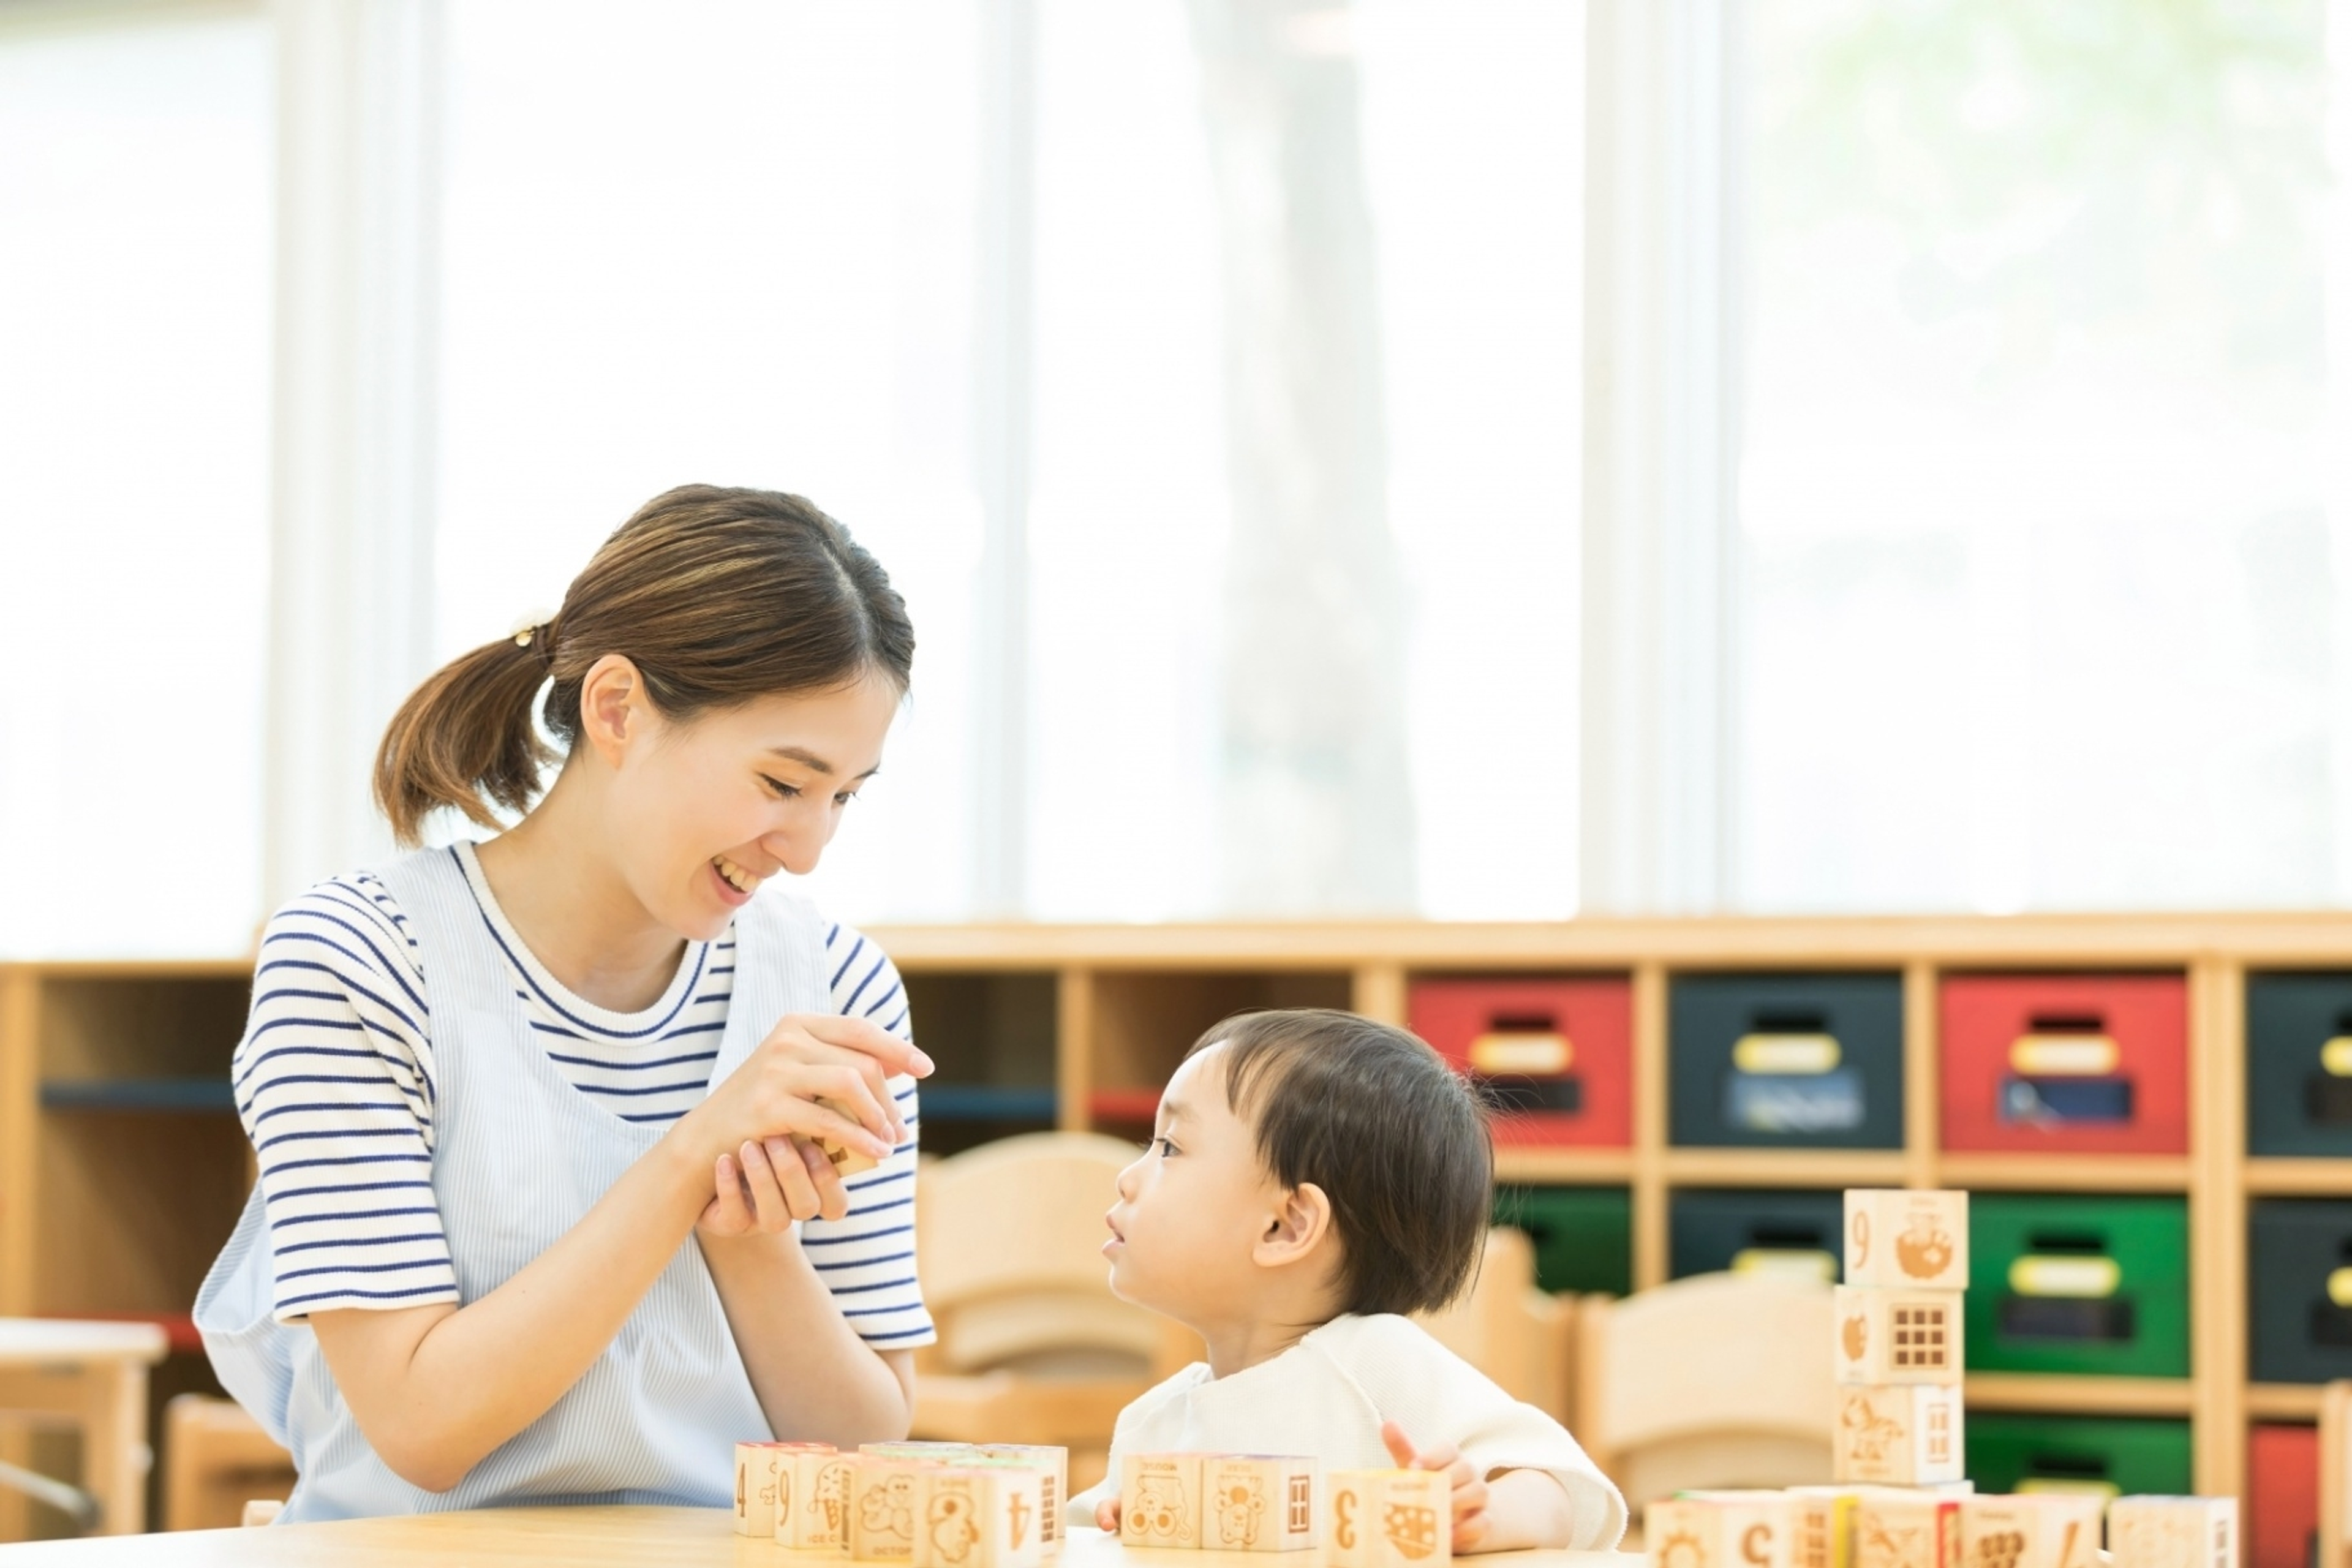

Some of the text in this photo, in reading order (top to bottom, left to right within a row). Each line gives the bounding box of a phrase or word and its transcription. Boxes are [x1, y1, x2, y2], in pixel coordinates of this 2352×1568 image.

[737, 1463, 746, 1518] 4
[1143, 1463, 1177, 1471] MOUSE
[779, 1469, 790, 1527] 9
[1008, 1492, 1031, 1551] 4
[1336, 1490, 1357, 1551] 3
[807, 1534, 826, 1543] ICE
